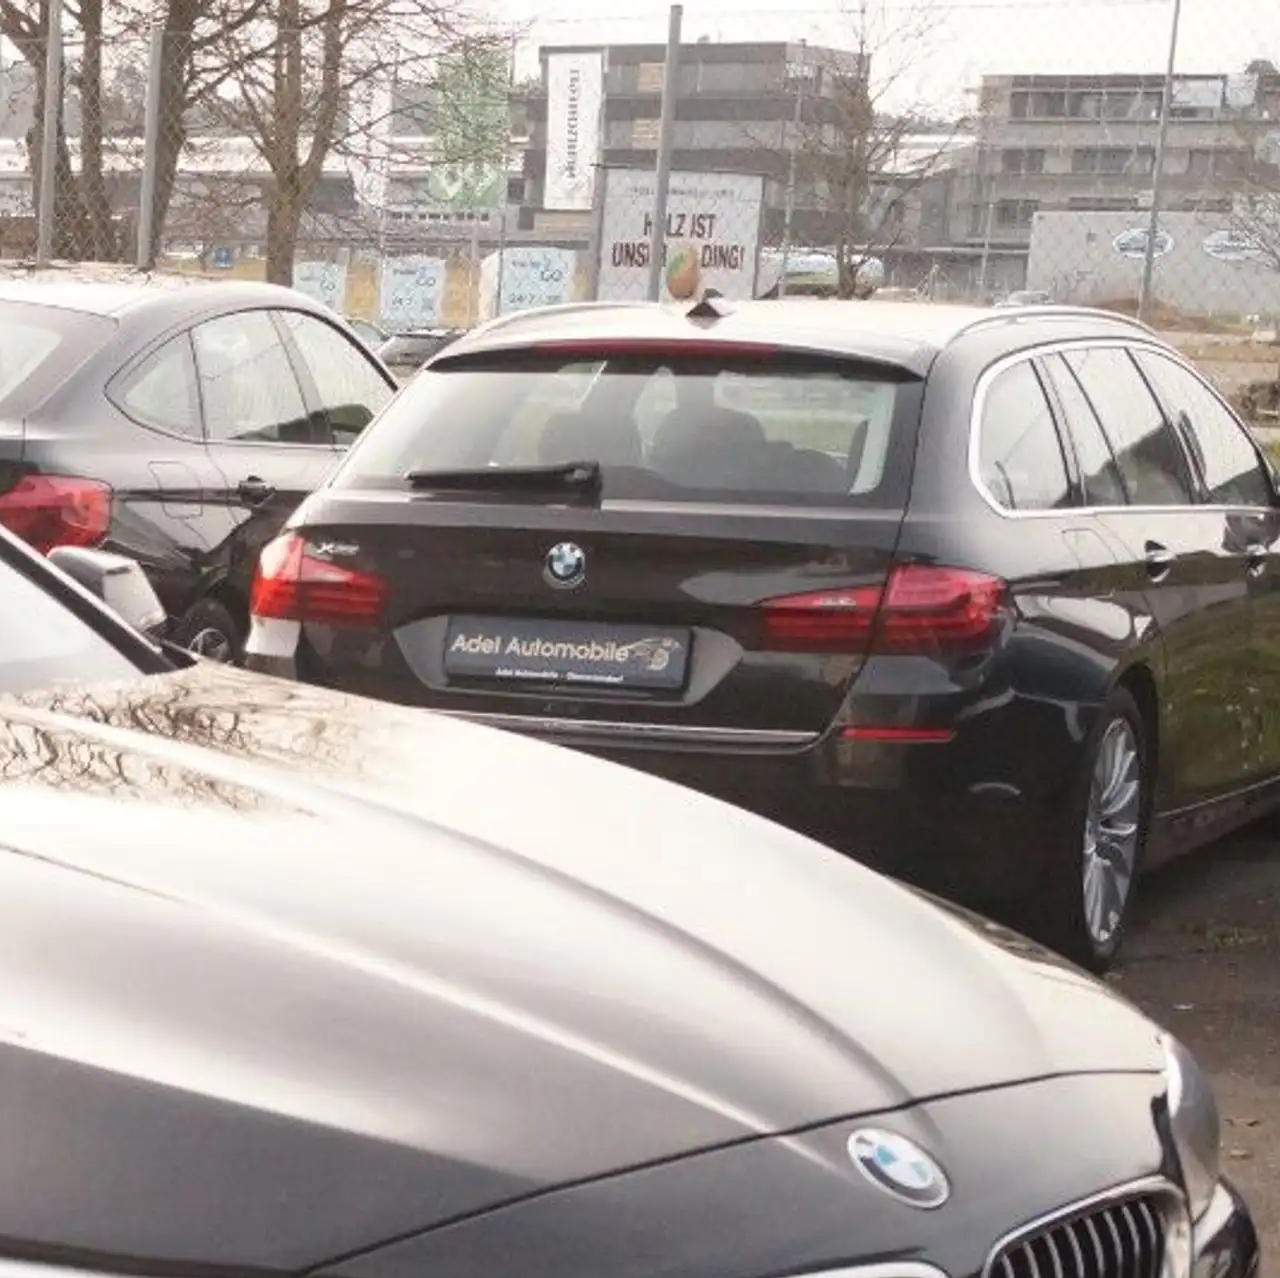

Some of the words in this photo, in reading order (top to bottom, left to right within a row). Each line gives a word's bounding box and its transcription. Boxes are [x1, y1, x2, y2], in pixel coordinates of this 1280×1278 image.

[644, 212, 686, 237] HLZ
[690, 213, 716, 239] IST
[701, 244, 746, 270] DING!
[451, 634, 502, 654] Adel
[505, 636, 629, 662] Automobile
